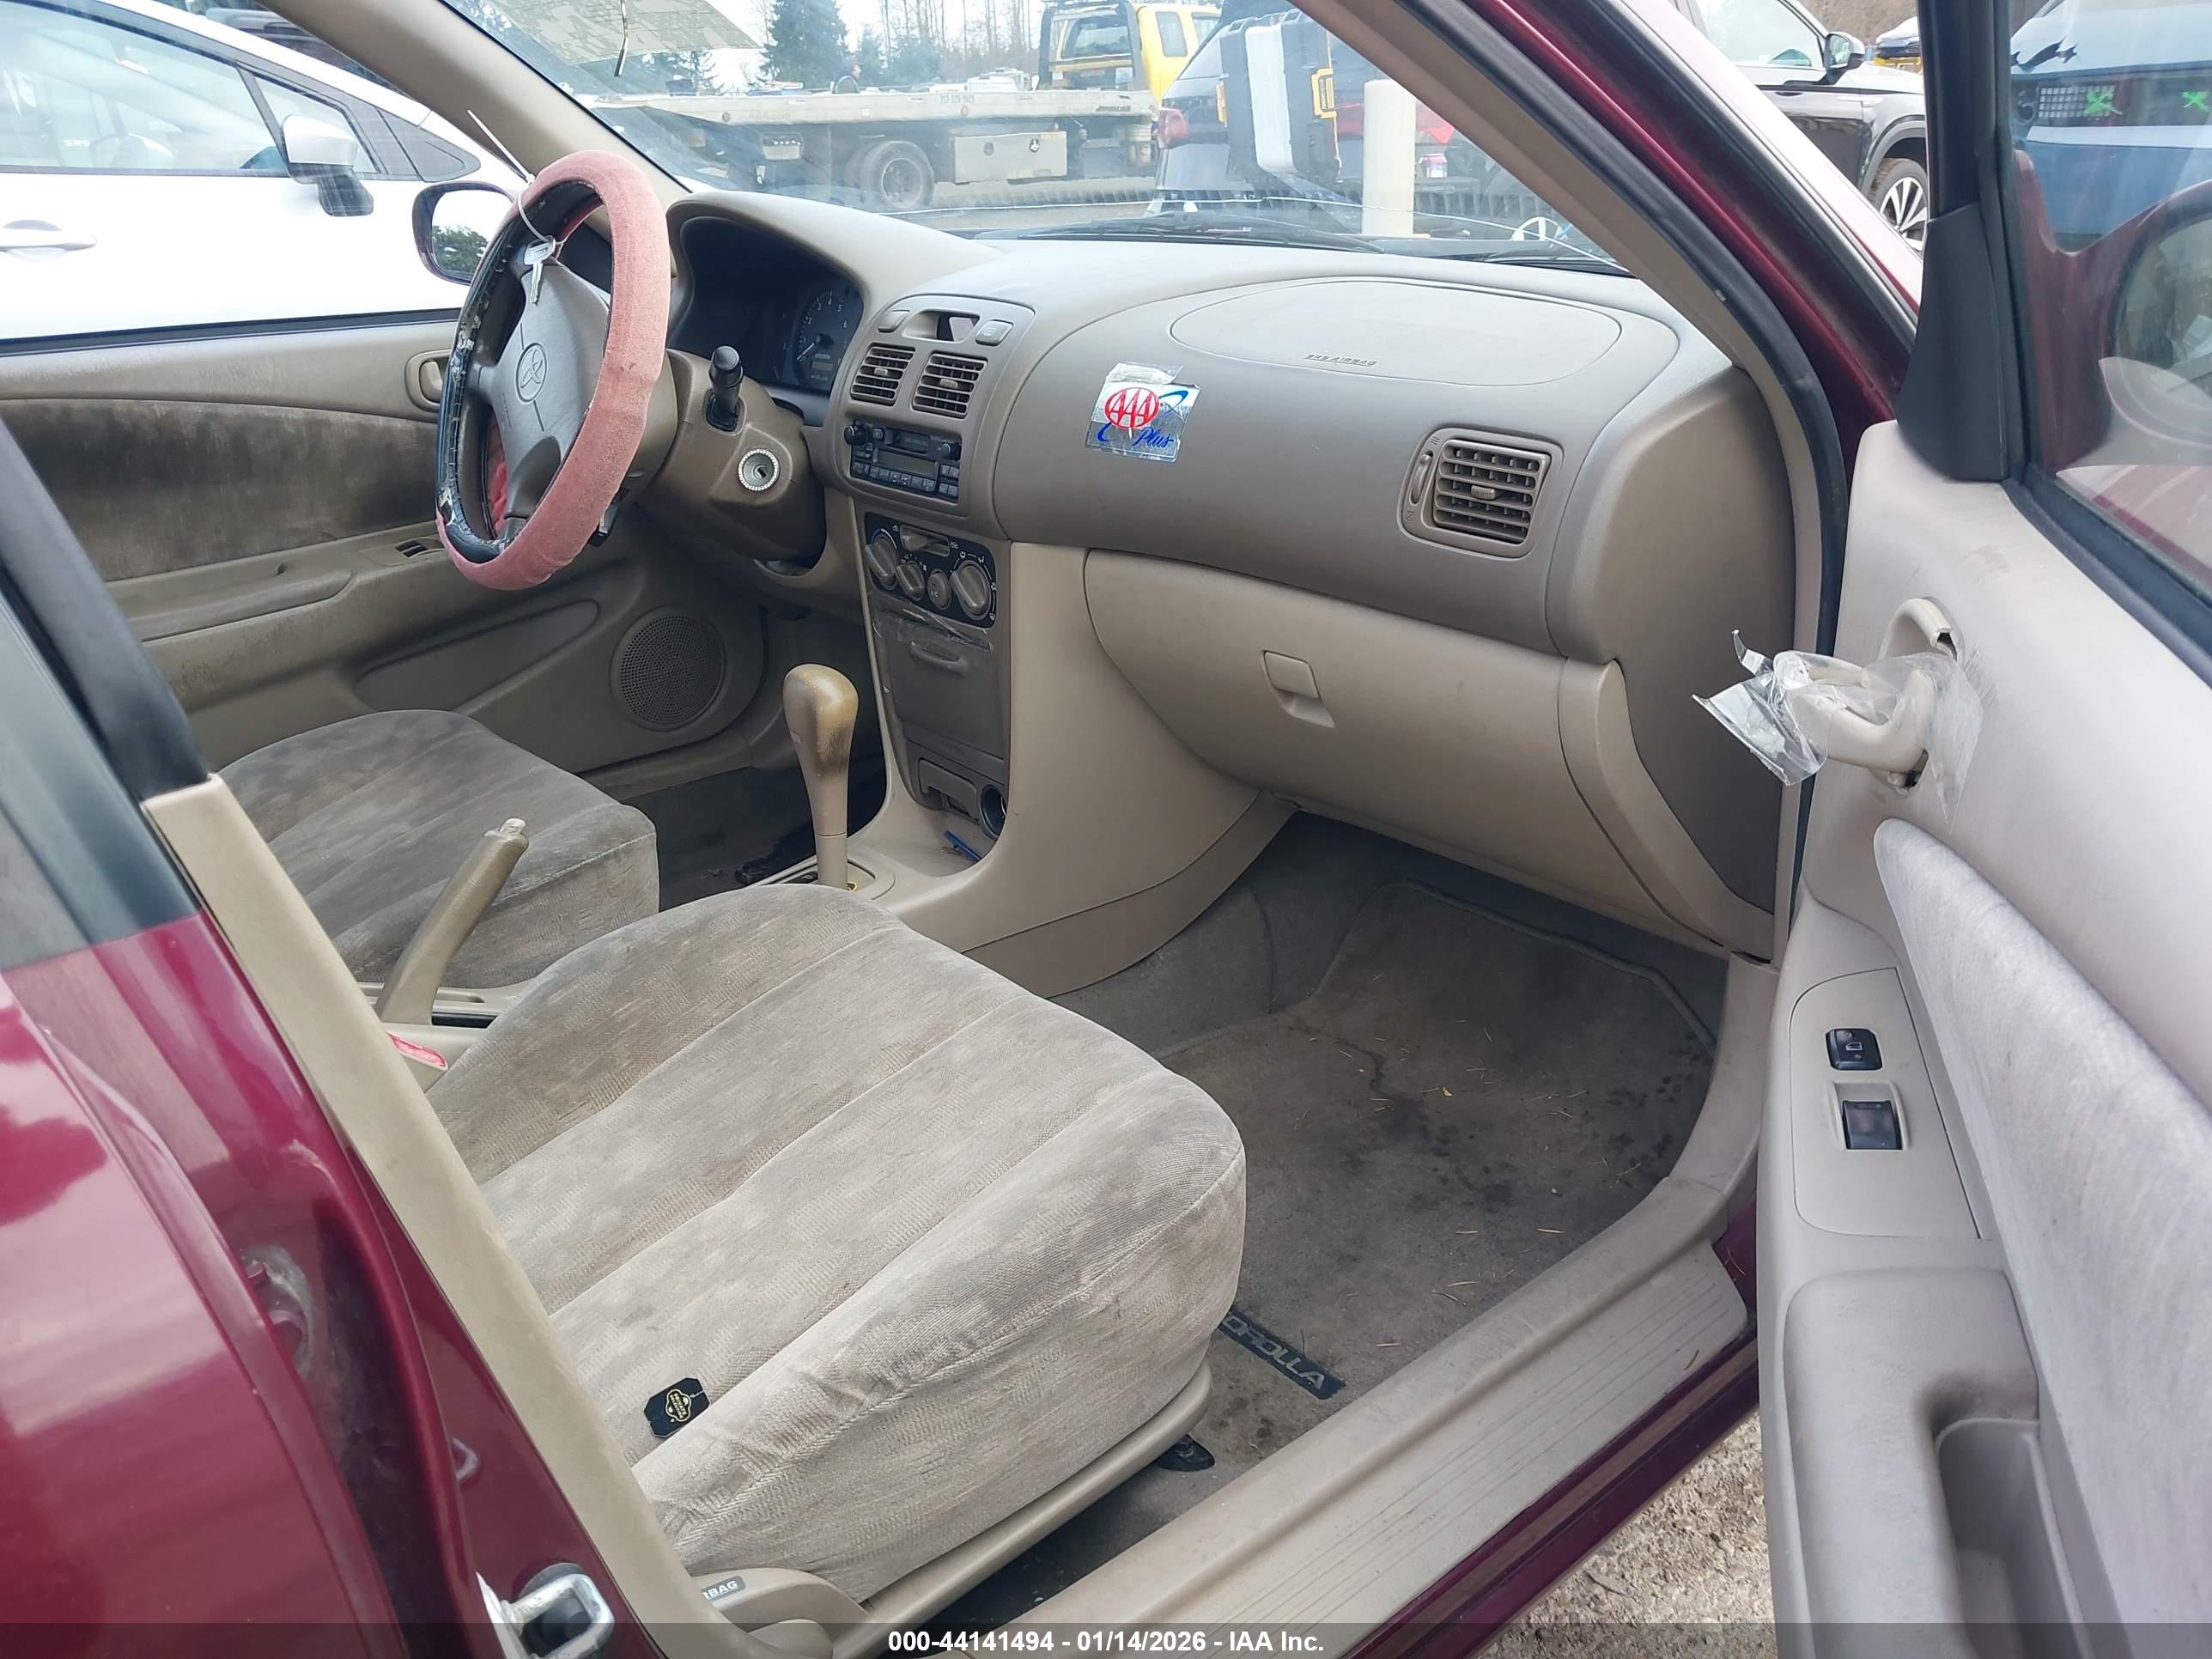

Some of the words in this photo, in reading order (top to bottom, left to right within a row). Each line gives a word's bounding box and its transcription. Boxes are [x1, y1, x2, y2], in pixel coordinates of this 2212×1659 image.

[1331, 356, 1377, 367] AIRBAG
[1105, 387, 1159, 428] AAA
[1131, 426, 1174, 447] Plus
[1222, 1315, 1325, 1390] OROLLA
